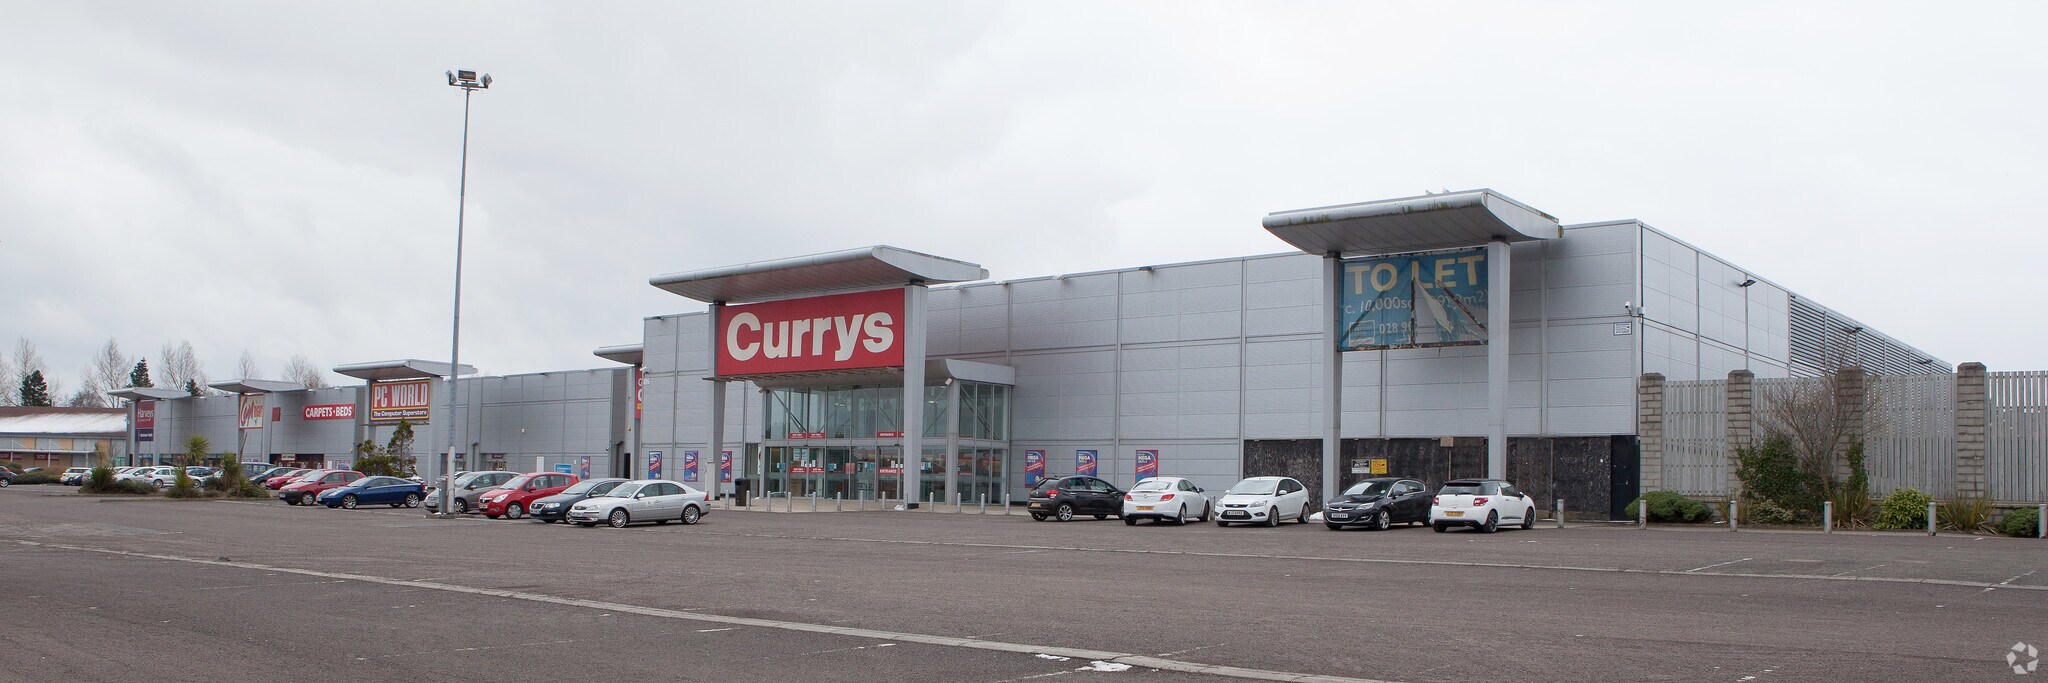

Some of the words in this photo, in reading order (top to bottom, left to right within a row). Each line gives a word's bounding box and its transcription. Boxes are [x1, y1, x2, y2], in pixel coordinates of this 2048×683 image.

[1345, 263, 1398, 295] TO
[1411, 255, 1485, 289] LET
[726, 311, 895, 362] Currys
[1380, 322, 1398, 334] 028
[374, 385, 388, 408] PC
[391, 383, 428, 407] WORLD
[305, 407, 333, 418] CARPETS
[335, 406, 352, 417] BEDS
[381, 410, 402, 418] Computer
